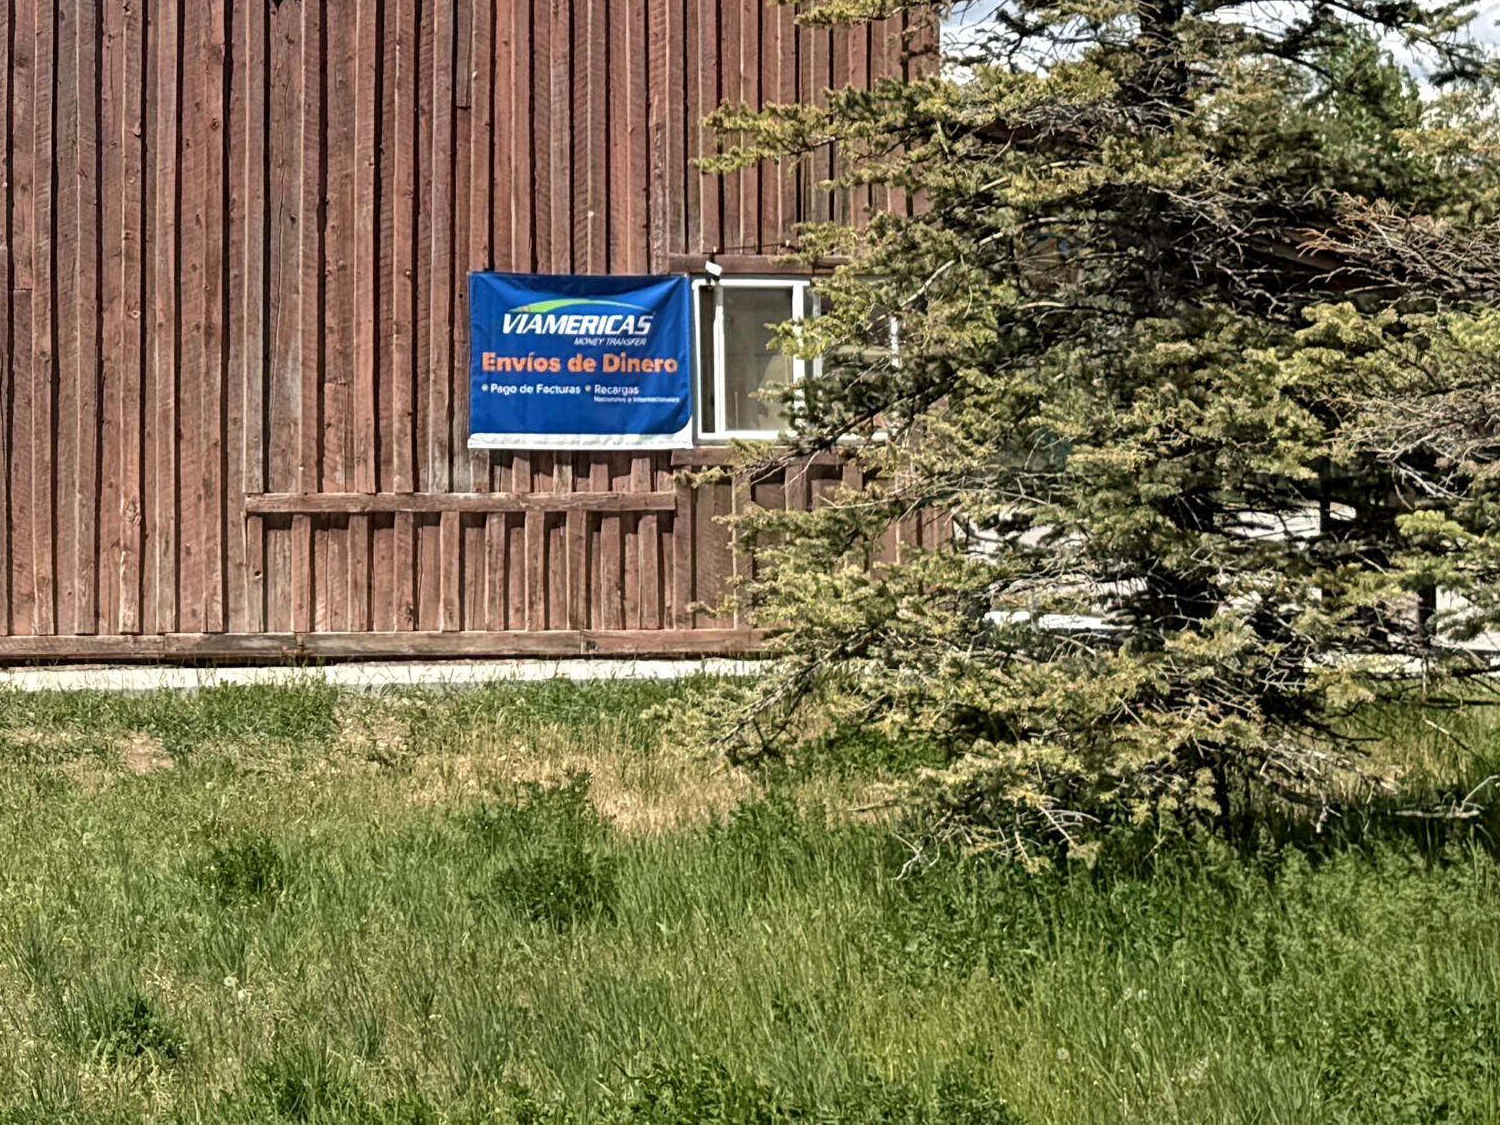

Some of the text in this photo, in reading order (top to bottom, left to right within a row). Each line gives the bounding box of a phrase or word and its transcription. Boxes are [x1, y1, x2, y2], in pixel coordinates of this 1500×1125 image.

[502, 313, 654, 335] VIAMERICAS
[573, 337, 647, 347] MONEY TRANSFER
[482, 351, 678, 374] Envíos de Dinero
[490, 384, 640, 396] Pago de Facturas Recargas
